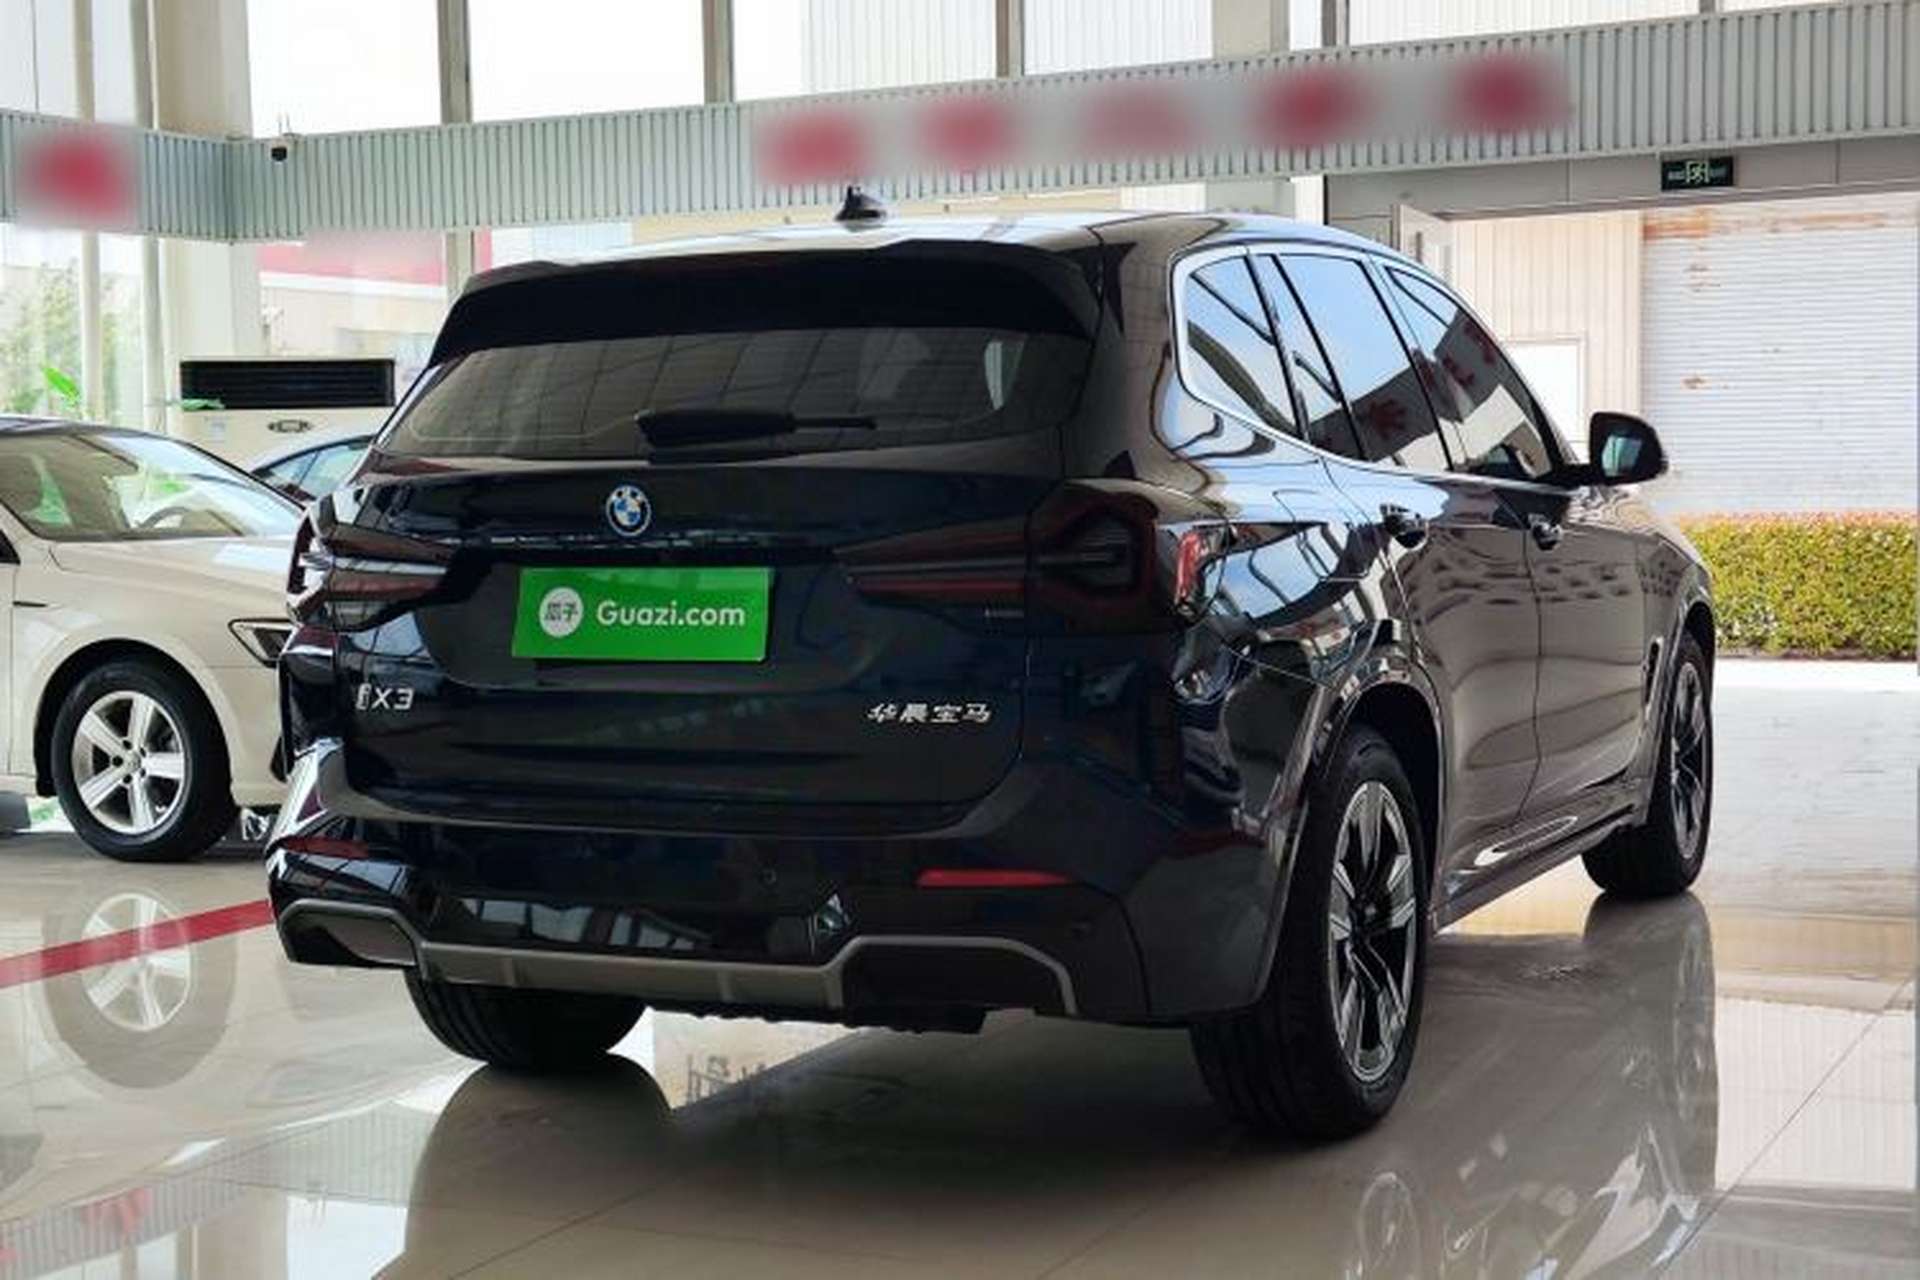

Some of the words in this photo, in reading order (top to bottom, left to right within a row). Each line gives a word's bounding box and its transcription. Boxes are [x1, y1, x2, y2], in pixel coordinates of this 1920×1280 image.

[597, 600, 745, 626] Guazi.com
[867, 703, 991, 723] 华晨宝马
